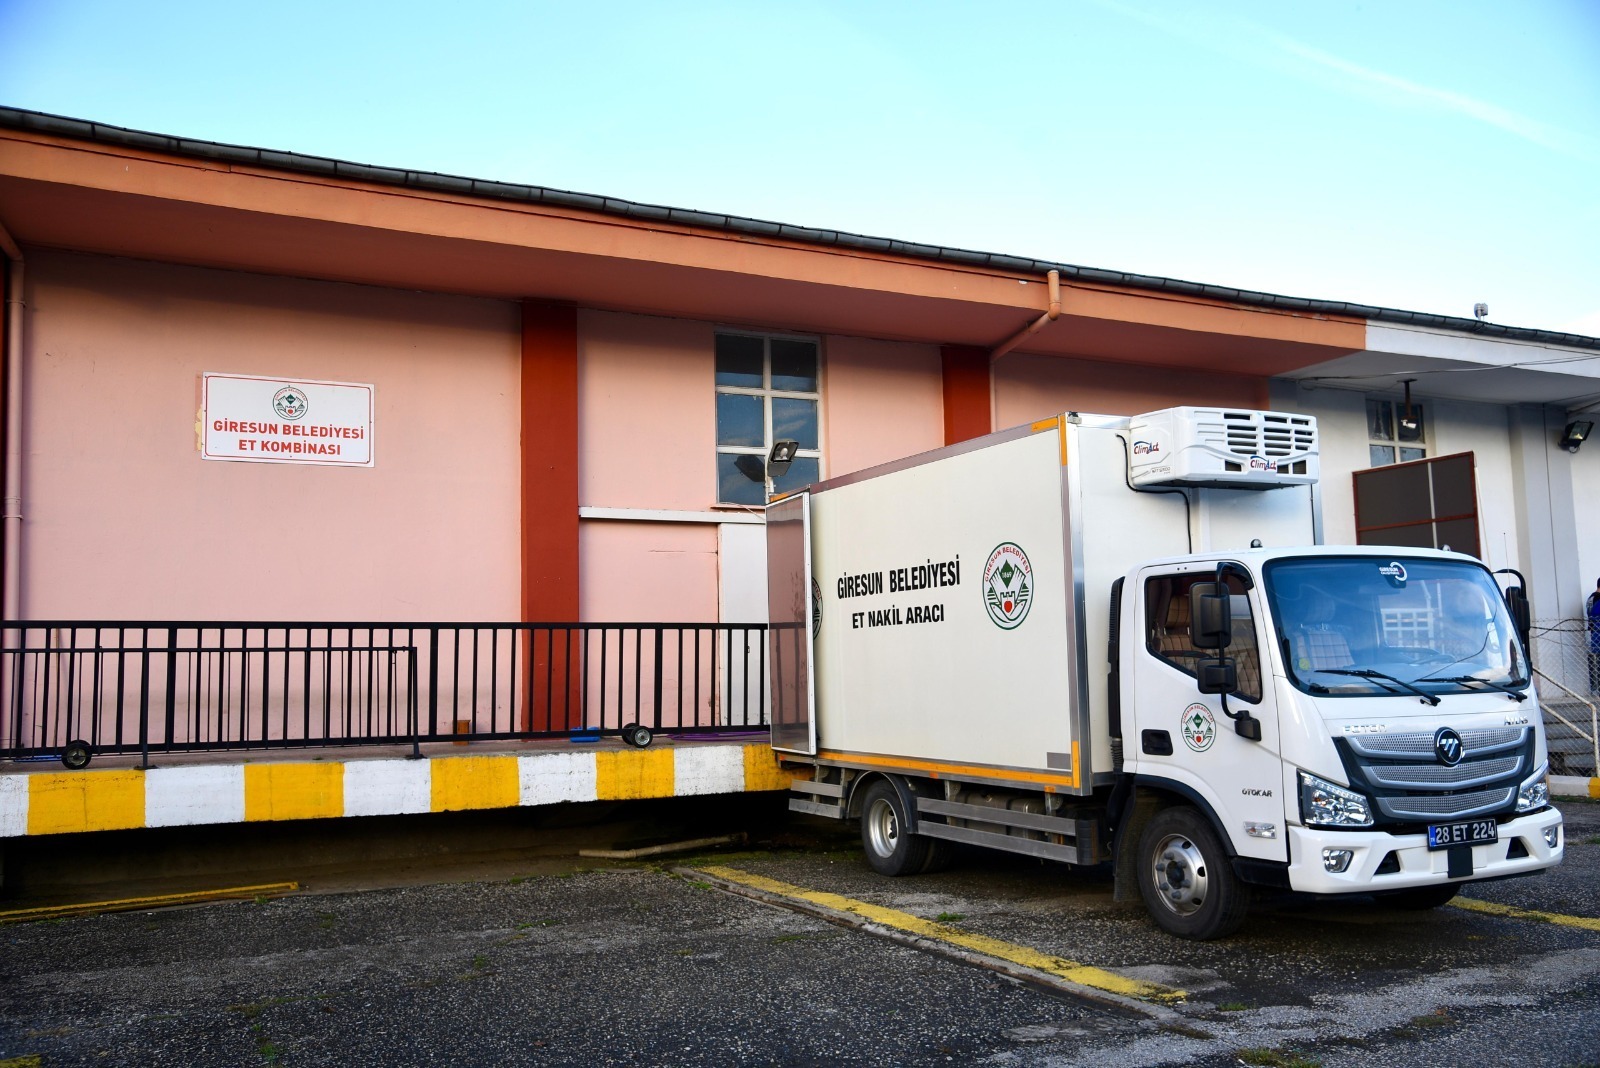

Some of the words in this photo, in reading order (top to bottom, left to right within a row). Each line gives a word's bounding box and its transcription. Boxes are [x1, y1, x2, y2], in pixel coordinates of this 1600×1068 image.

[213, 418, 278, 434] GİRESUN
[282, 424, 364, 439] BELEDİYESİ
[238, 440, 257, 451] ET
[261, 440, 341, 455] KOMBİNASI
[837, 572, 883, 599] GİRESUN
[889, 554, 961, 593] BELEDİYESİ
[852, 612, 865, 629] ET
[868, 604, 903, 628] NAKİL
[905, 604, 945, 624] ARACI
[1241, 788, 1273, 798] OTOKAR
[1435, 827, 1450, 843] 28
[1452, 824, 1468, 841] ET
[1472, 822, 1495, 839] 224
